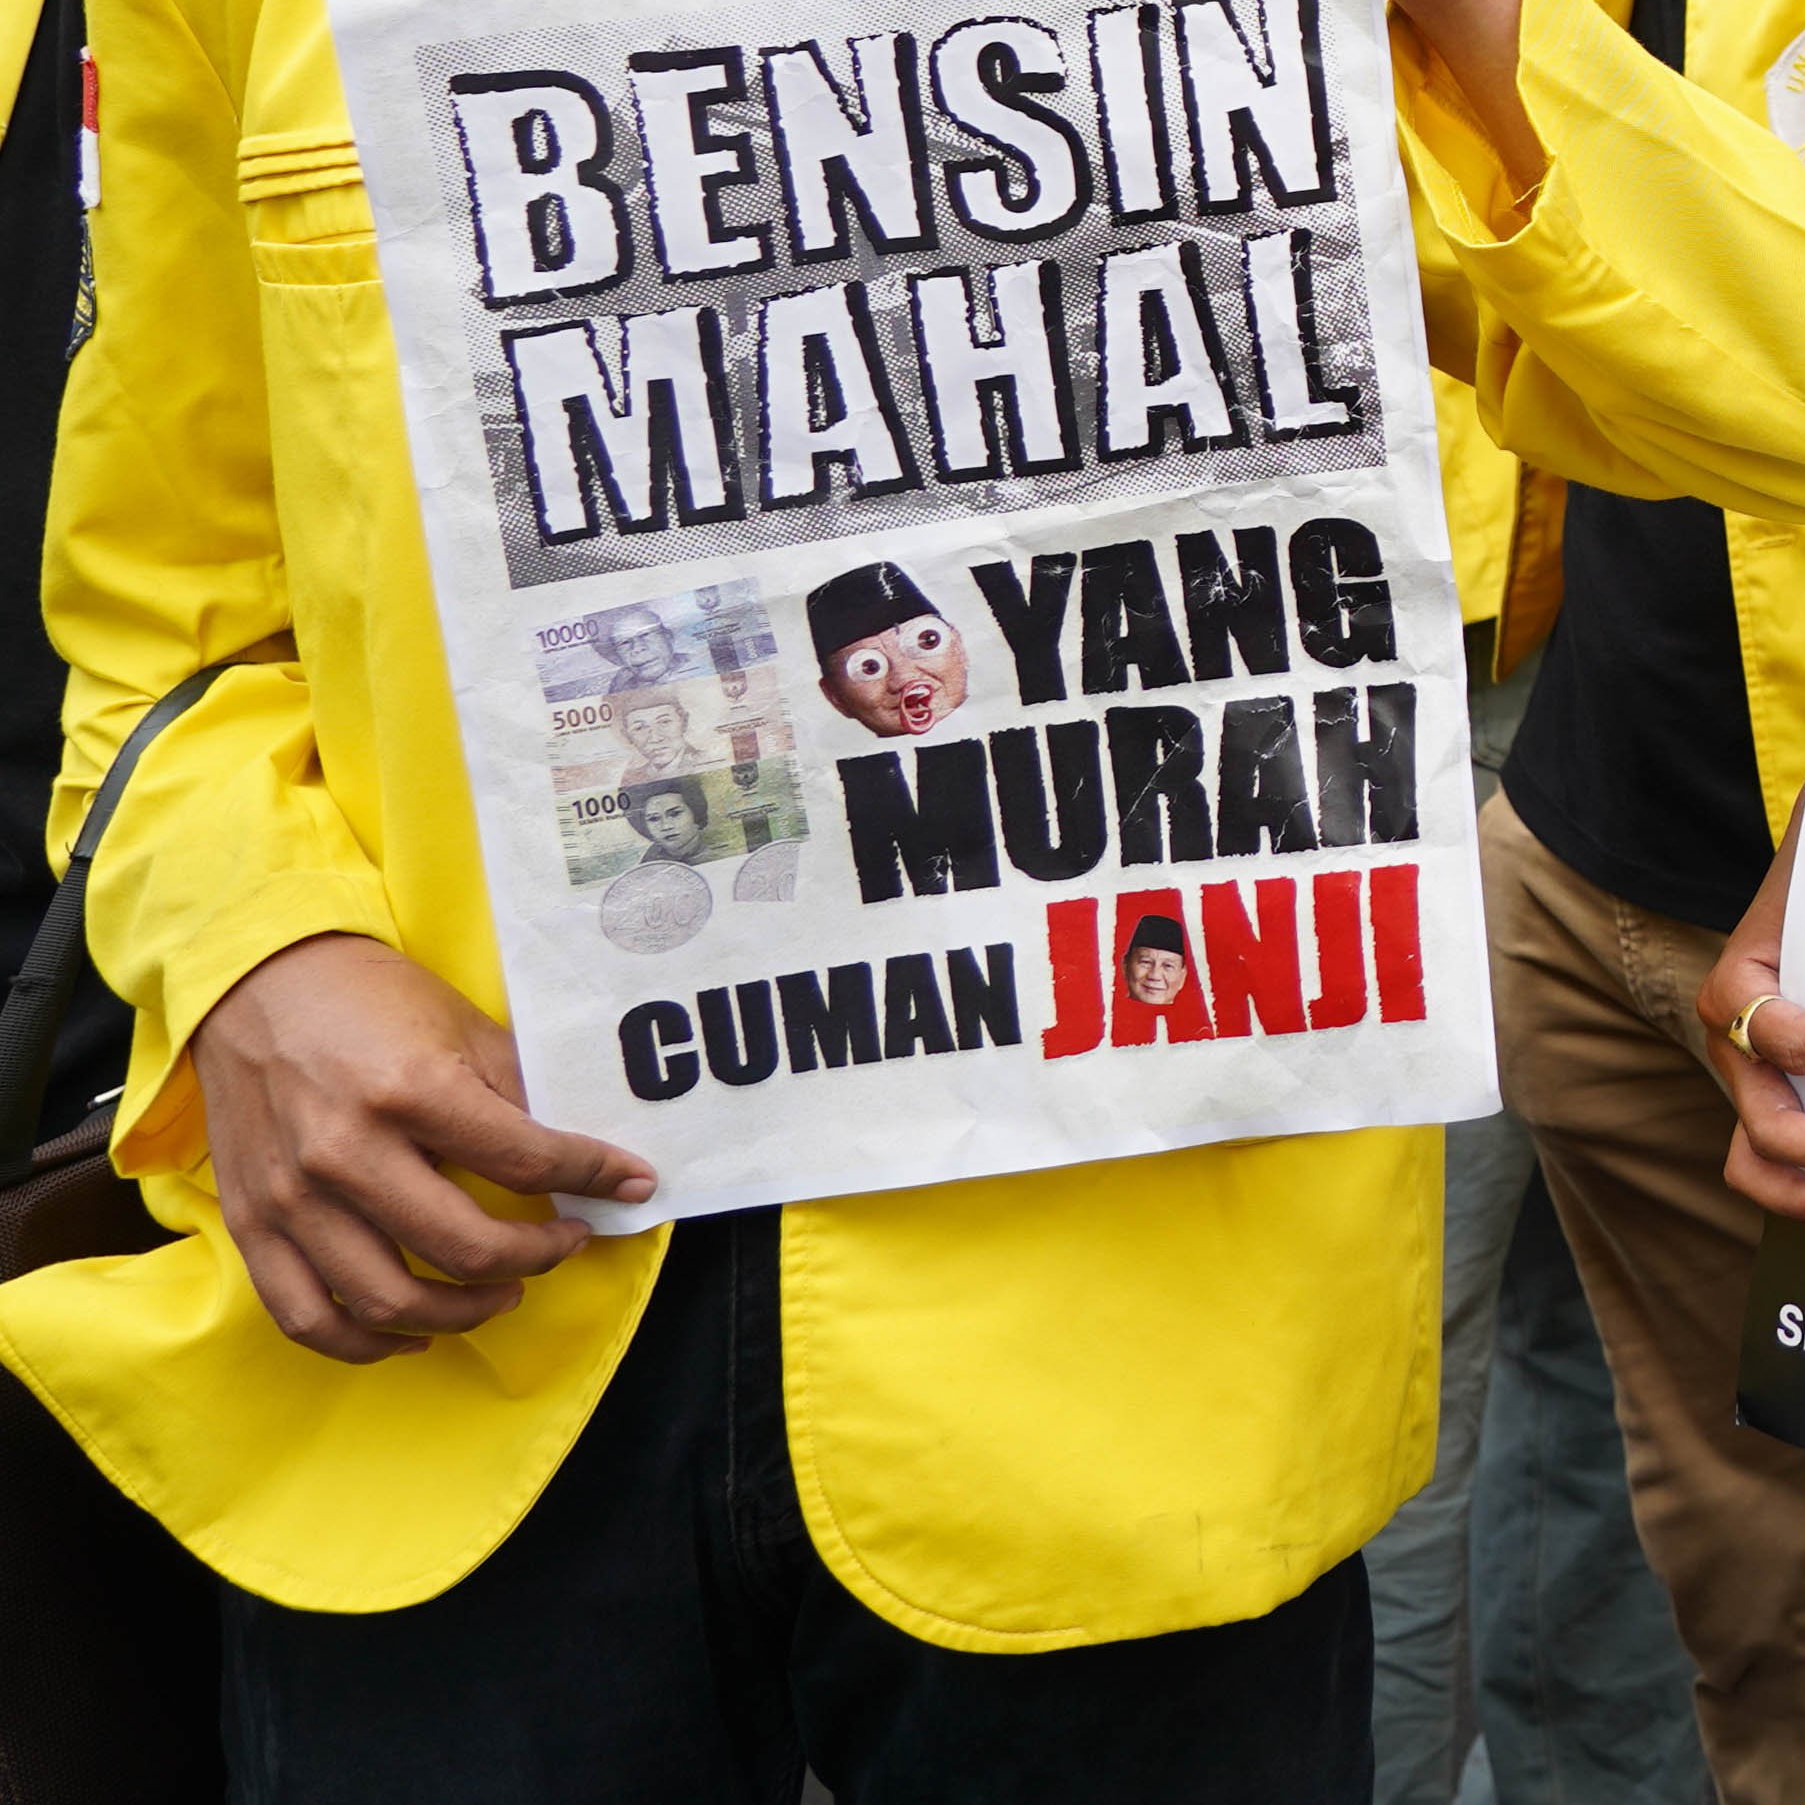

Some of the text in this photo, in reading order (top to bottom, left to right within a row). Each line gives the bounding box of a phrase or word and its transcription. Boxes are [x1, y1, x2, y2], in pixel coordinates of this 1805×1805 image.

[499, 227, 1366, 548] MAHAL
[536, 618, 600, 648] 10000
[970, 517, 1398, 707] YANG
[552, 703, 615, 731] 5000
[572, 792, 632, 819] 1000
[836, 681, 1422, 904] MURAH
[618, 863, 1426, 1102] CUMAN JANJI
